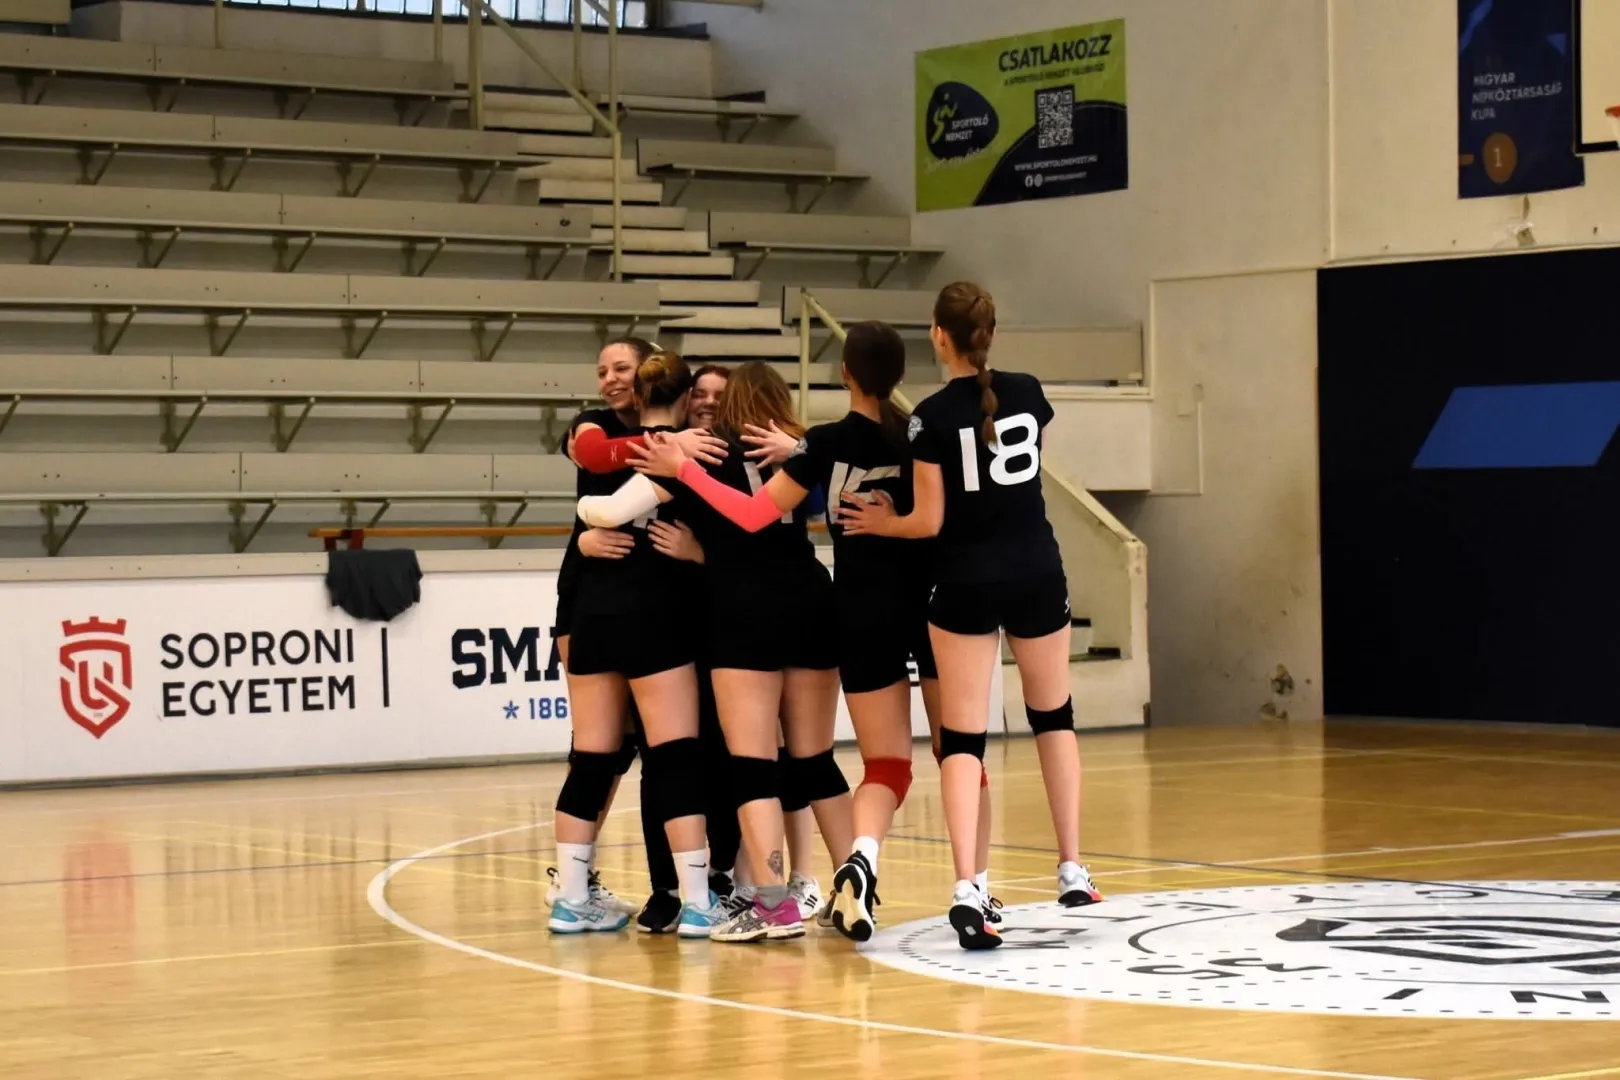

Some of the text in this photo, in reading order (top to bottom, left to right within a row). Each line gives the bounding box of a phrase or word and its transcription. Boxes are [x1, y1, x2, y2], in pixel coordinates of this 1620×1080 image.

[999, 34, 1112, 72] CSATLAKOZZ
[945, 129, 973, 142] NEMZET
[952, 113, 989, 130] SPORTOLÓ
[1494, 148, 1502, 168] 1
[958, 412, 1040, 492] 18
[160, 628, 354, 669] SOPRONI
[163, 675, 356, 718] EGYETEM
[529, 697, 568, 720] 186
